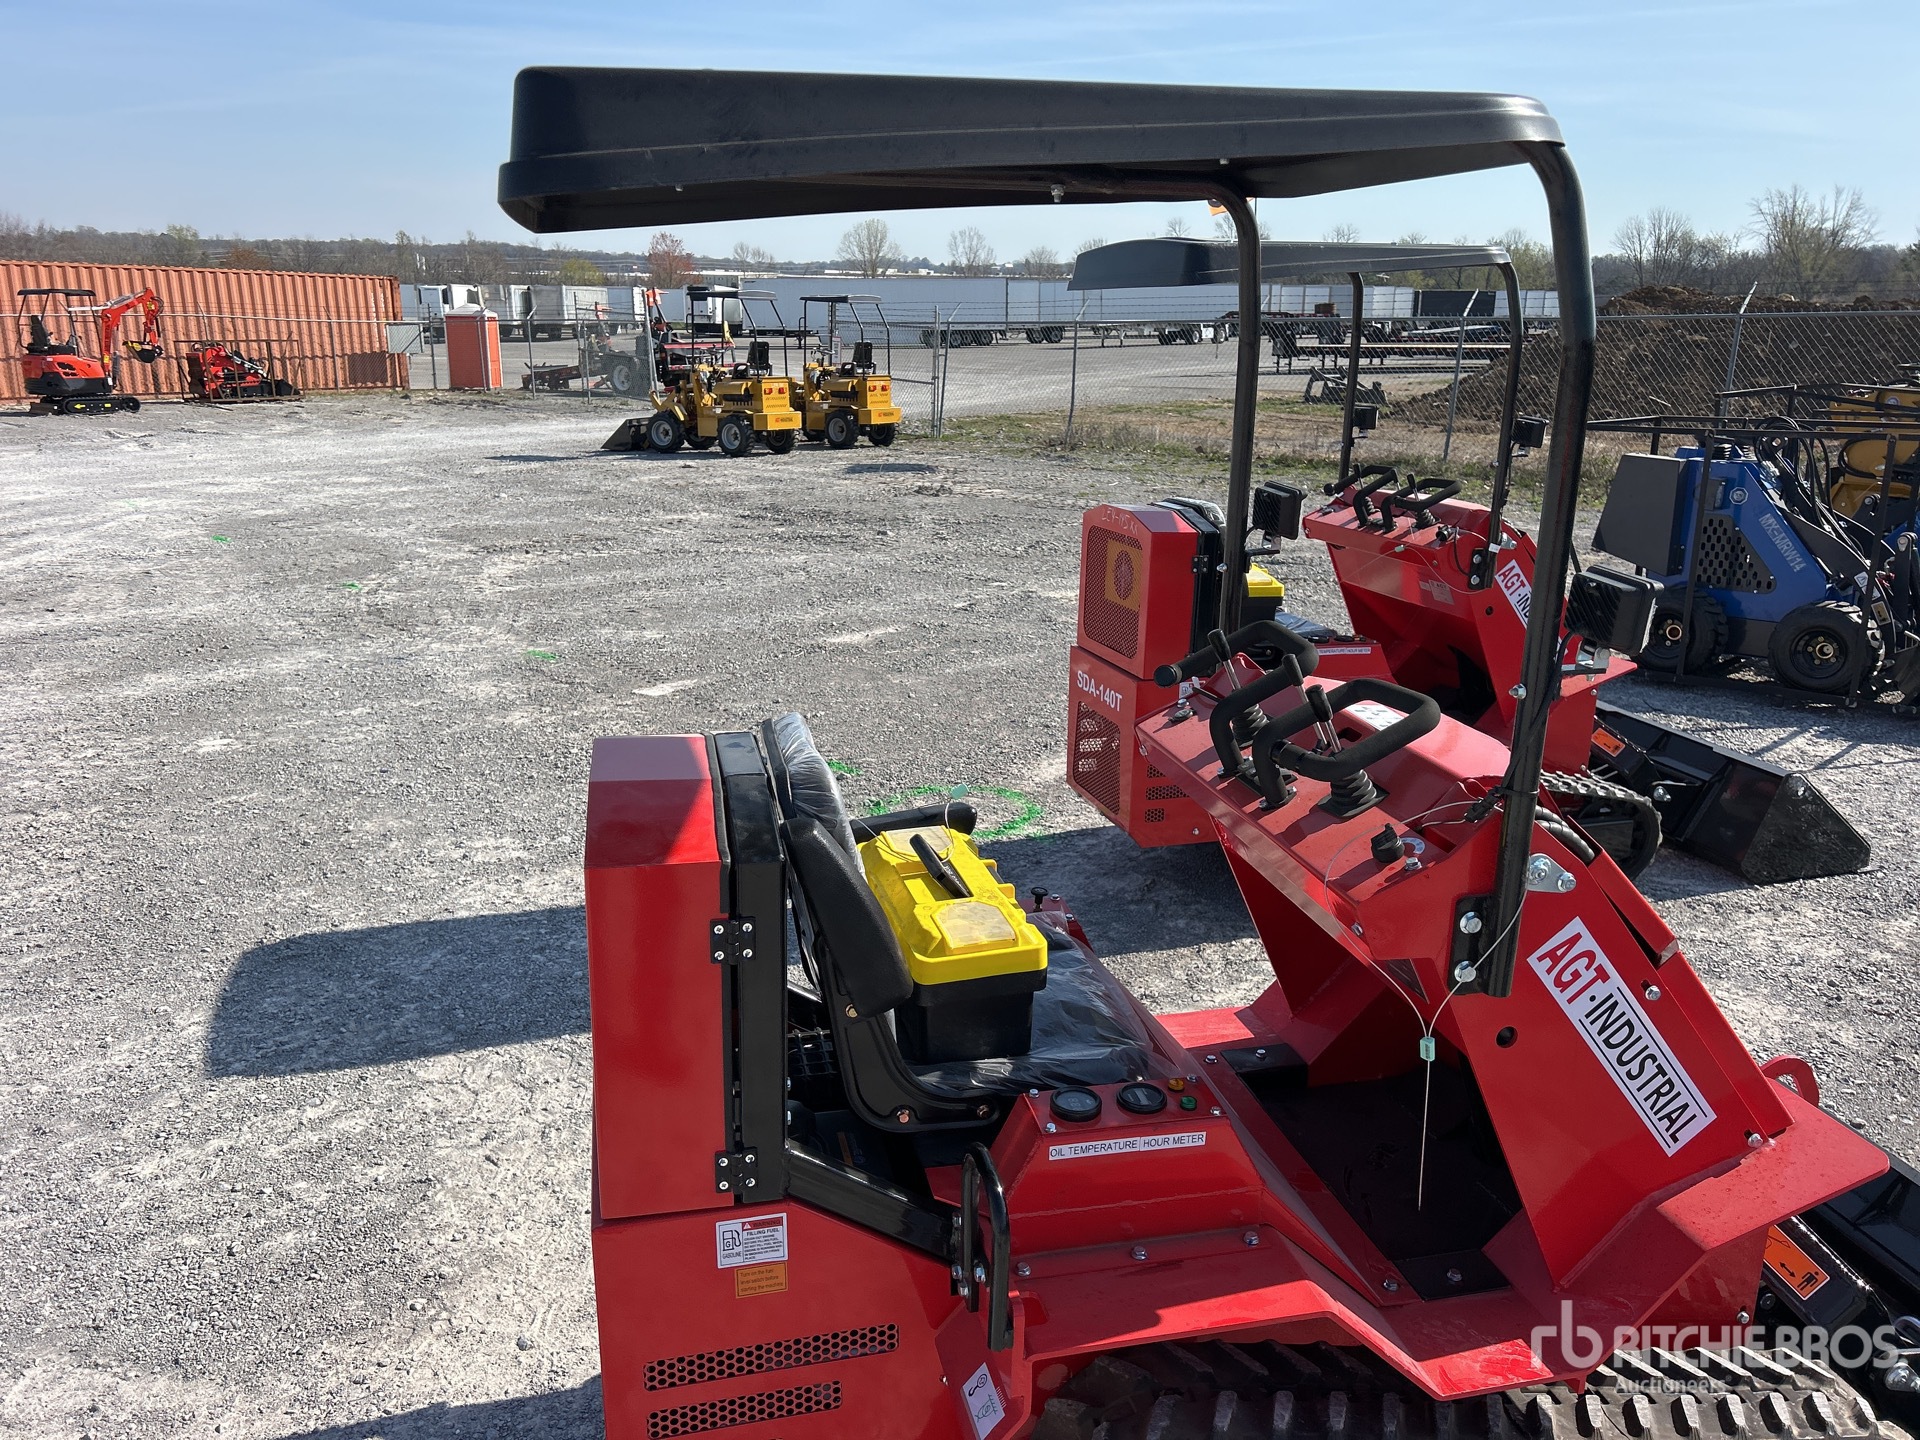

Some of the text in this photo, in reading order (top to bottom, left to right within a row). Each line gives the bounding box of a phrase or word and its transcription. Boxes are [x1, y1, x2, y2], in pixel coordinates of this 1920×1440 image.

[1498, 564, 1526, 597] AGT
[1076, 670, 1122, 712] SDA-140T
[1536, 932, 1697, 1144] AGT INDUSTRIAL
[1050, 1133, 1204, 1158] OIL TEMPERATURE HOUR METER
[722, 1251, 741, 1259] GASOLINE
